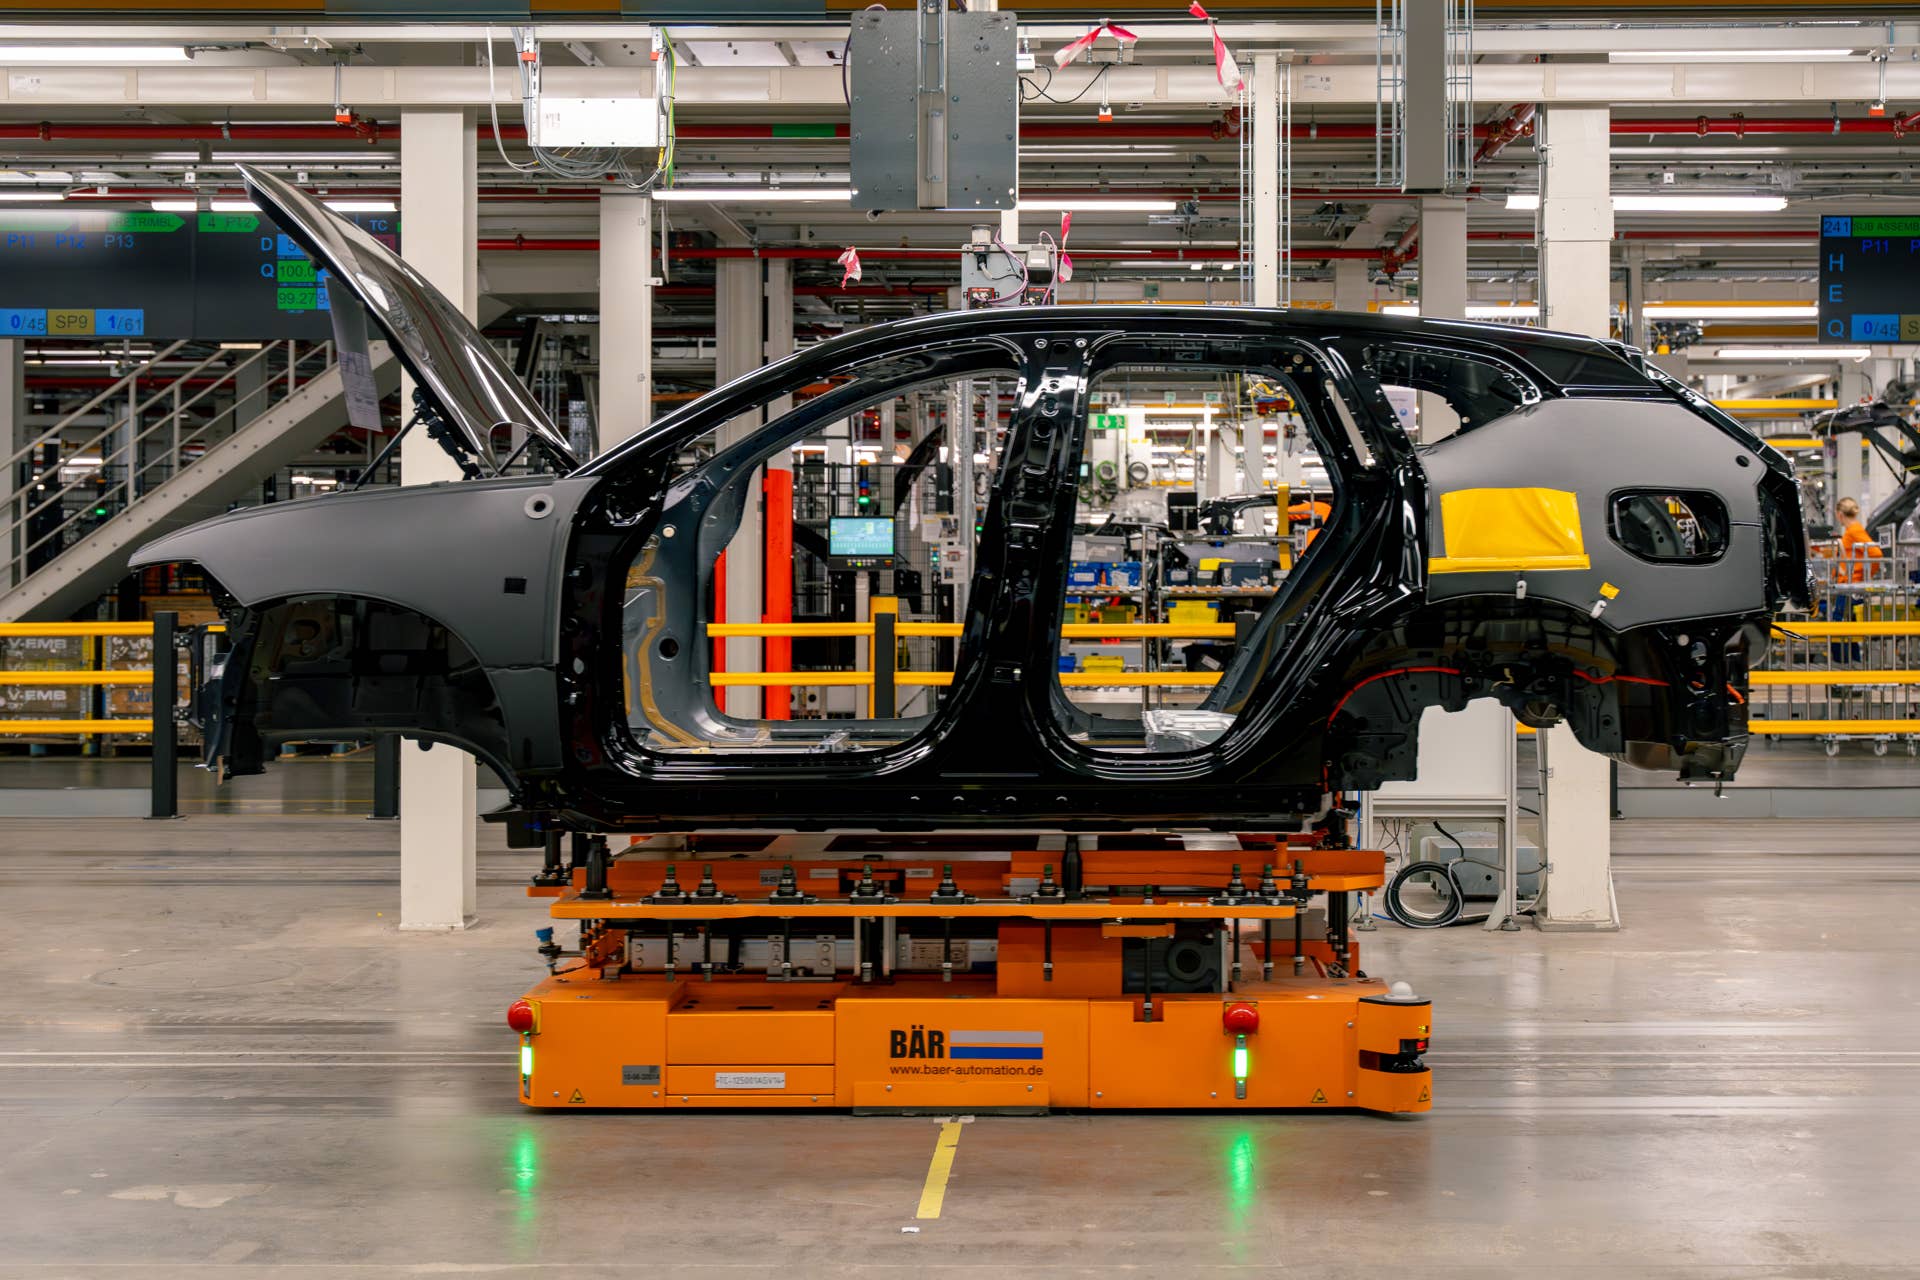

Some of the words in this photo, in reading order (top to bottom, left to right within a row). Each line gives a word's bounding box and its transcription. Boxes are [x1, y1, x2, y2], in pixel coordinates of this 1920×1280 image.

[207, 216, 216, 229] 4
[368, 219, 388, 232] TC
[1824, 220, 1848, 233] 241
[7, 234, 35, 248] P11
[56, 234, 86, 248] P12
[104, 234, 135, 248] P13
[261, 237, 273, 251] D
[1862, 239, 1889, 254] P11
[1829, 253, 1844, 272] H
[261, 263, 274, 278] Q
[279, 292, 315, 305] 99.27
[1829, 284, 1843, 303] E
[11, 315, 46, 331] 0/45
[56, 315, 88, 329] SP9
[108, 315, 142, 331] 1/61
[1827, 319, 1844, 337] Q
[1863, 320, 1898, 336] 0/45
[890, 1025, 944, 1058] BÄR
[890, 1065, 1043, 1076] www.baer-automation.de
